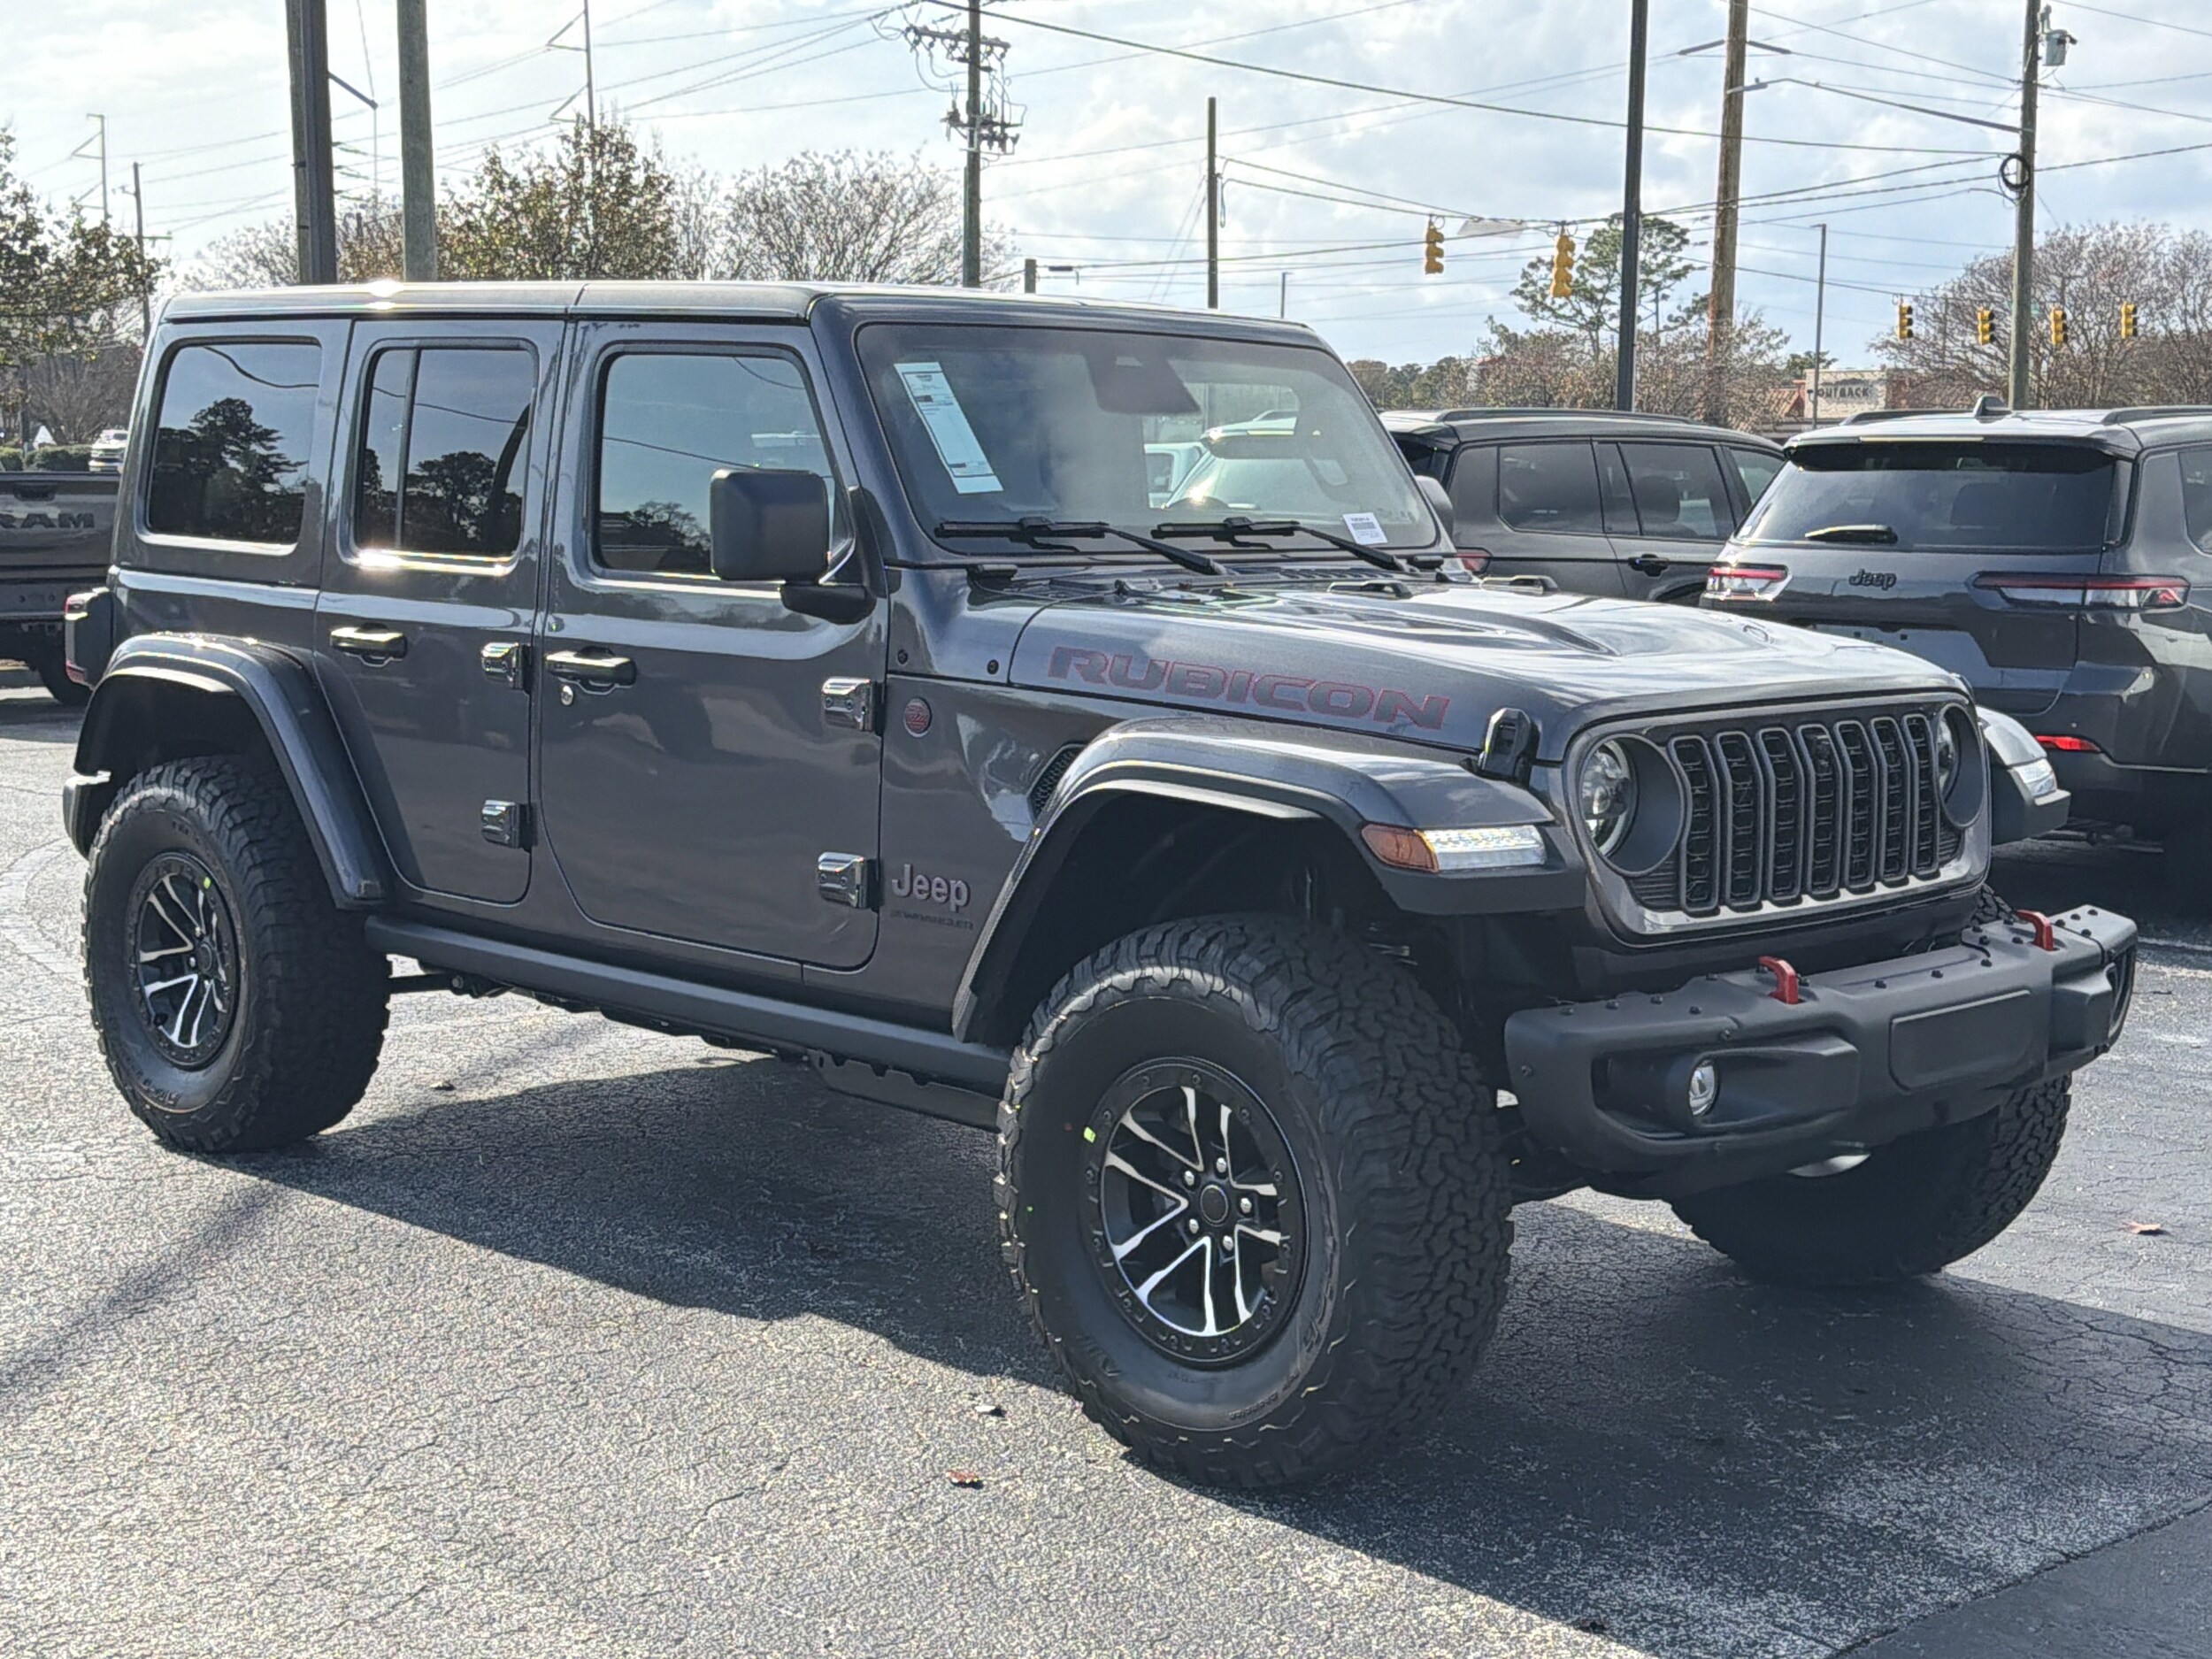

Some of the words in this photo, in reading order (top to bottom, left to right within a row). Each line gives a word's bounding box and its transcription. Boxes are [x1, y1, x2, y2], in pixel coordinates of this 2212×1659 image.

[1817, 387, 1870, 398] OUTBACK
[1848, 568, 1897, 591] Jeep
[1048, 646, 1450, 729] RUBICON
[891, 864, 971, 912] Jeep
